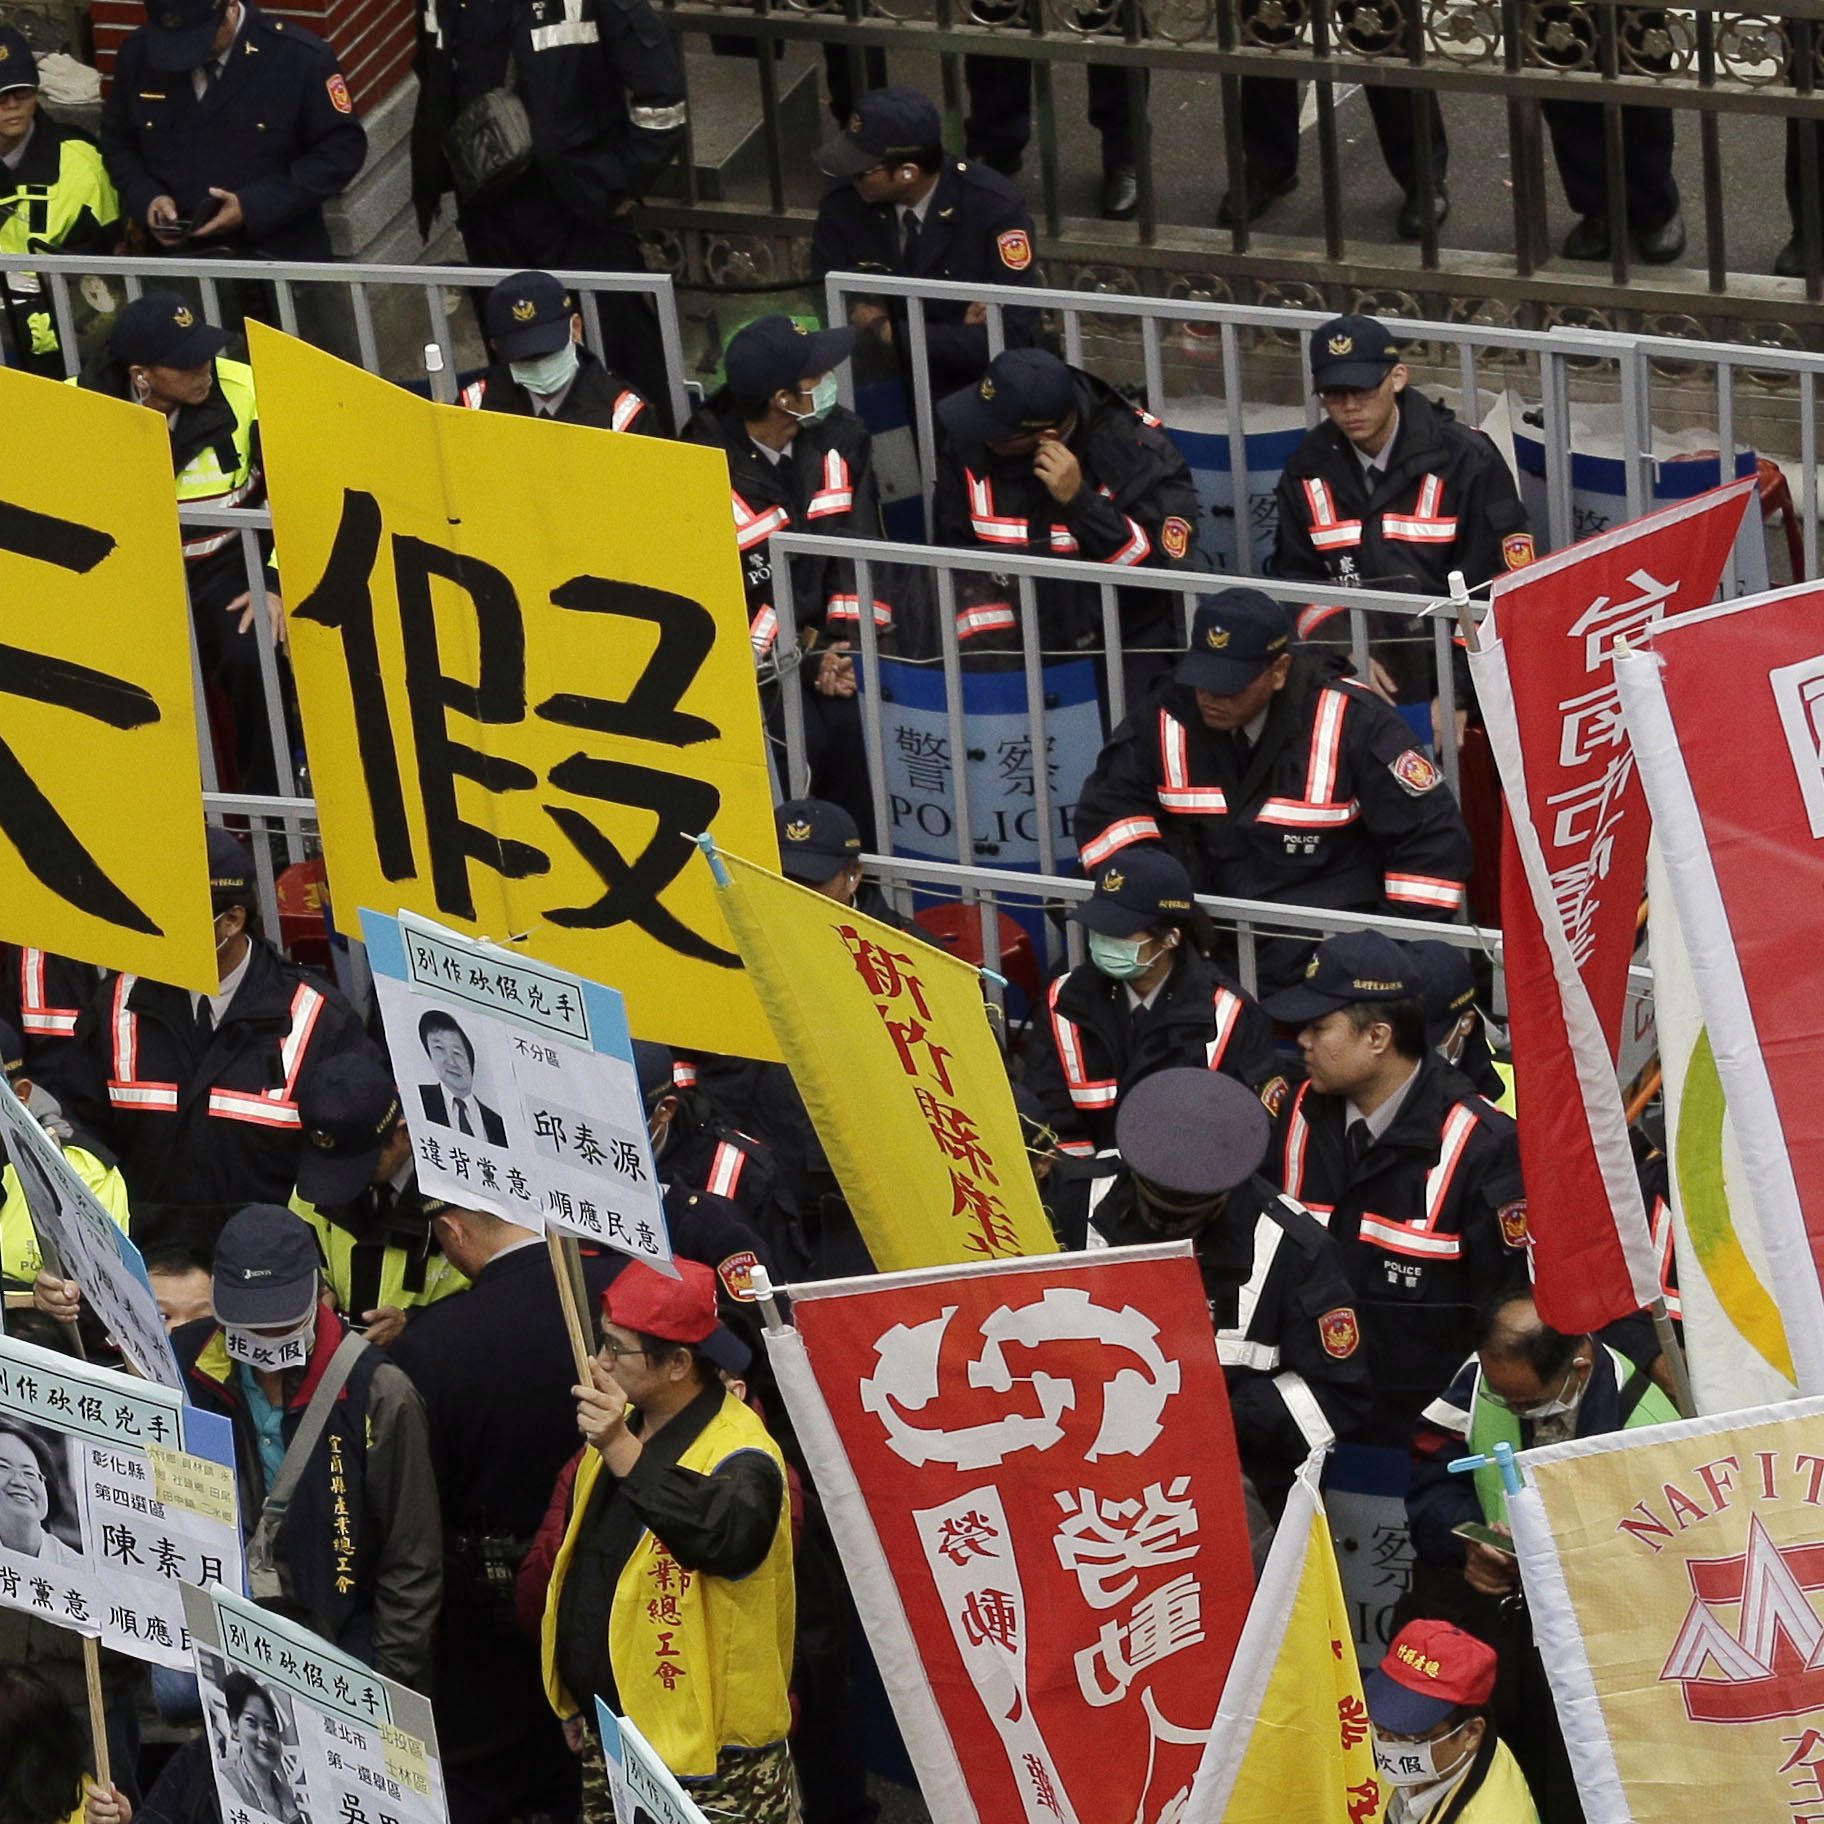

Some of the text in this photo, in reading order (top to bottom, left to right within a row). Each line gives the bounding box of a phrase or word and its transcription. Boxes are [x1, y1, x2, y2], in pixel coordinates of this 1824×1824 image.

[294, 488, 743, 969] 假
[514, 1036, 561, 1067] 不分區
[533, 1109, 648, 1182] 邱泰源
[228, 1335, 302, 1369] 拒砍假
[91, 1450, 146, 1482] 彰化縣
[325, 1748, 402, 1800] 第一選舉區
